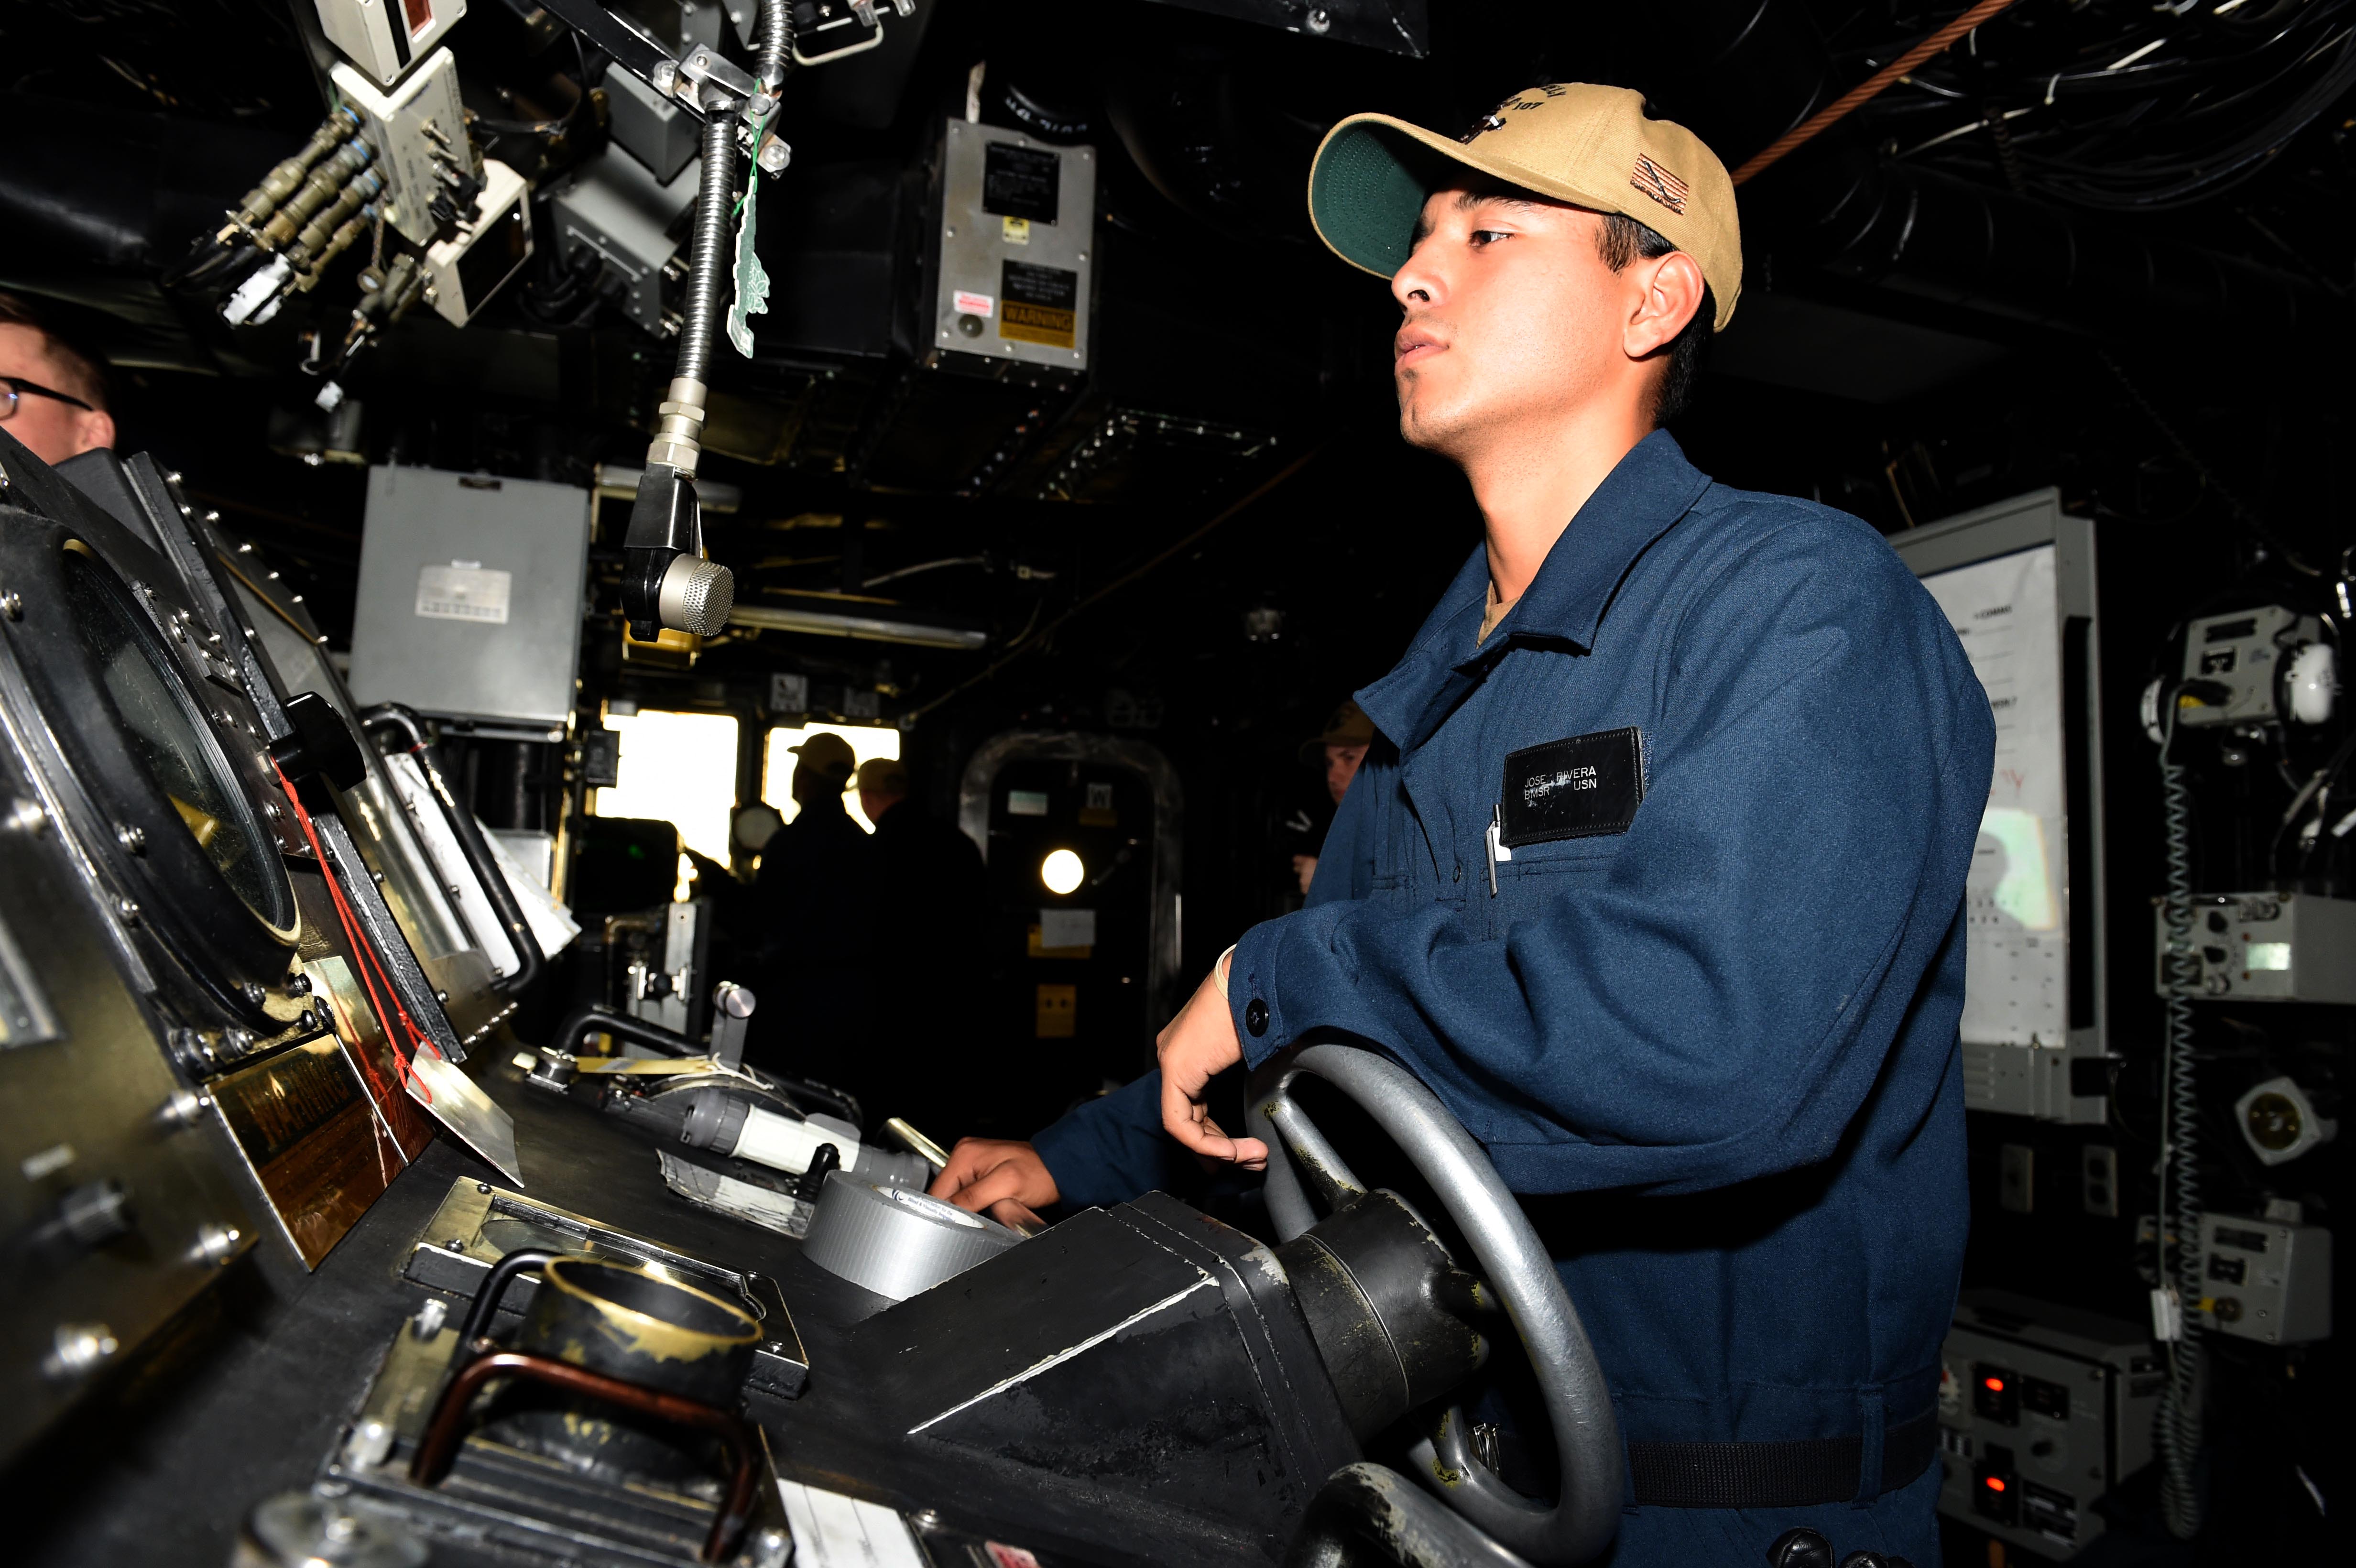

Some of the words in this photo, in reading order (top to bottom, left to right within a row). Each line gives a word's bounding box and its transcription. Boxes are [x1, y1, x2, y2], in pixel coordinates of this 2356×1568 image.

[1512, 102, 1545, 110] 107
[1004, 305, 1070, 331] WARNING
[1525, 774, 1546, 788] JOSE
[1556, 766, 1596, 782] RIVERA
[1524, 786, 1550, 800] BMSR
[1573, 778, 1597, 790] USN
[238, 1056, 350, 1149] WARNING
